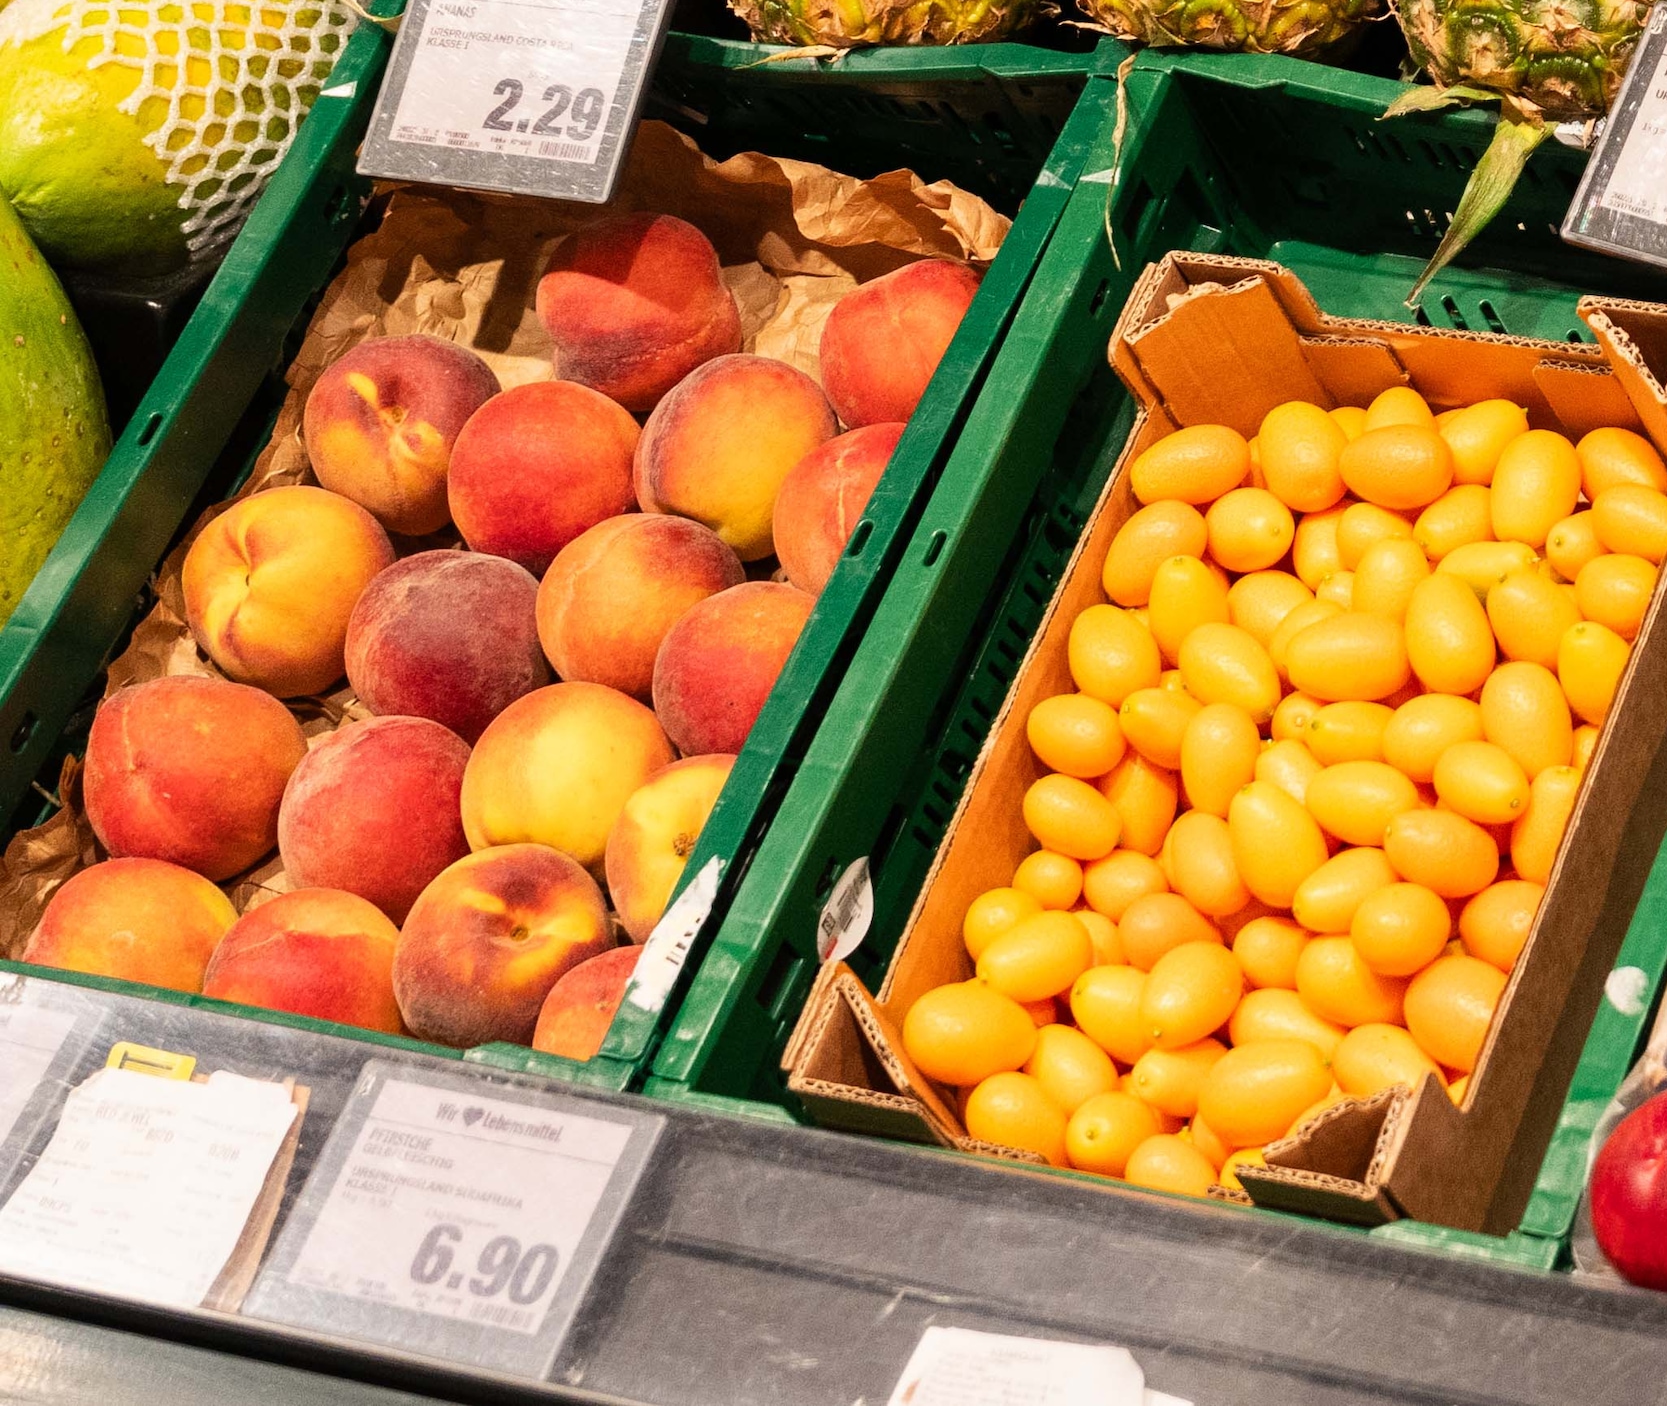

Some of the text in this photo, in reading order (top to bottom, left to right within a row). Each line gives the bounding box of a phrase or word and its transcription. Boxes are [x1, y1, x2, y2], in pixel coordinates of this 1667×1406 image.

[427, 36, 462, 49] KLASSE
[430, 27, 514, 44] URSPRUNGSLAND
[482, 78, 605, 141] 2.29
[409, 1223, 559, 1306] 6.90
